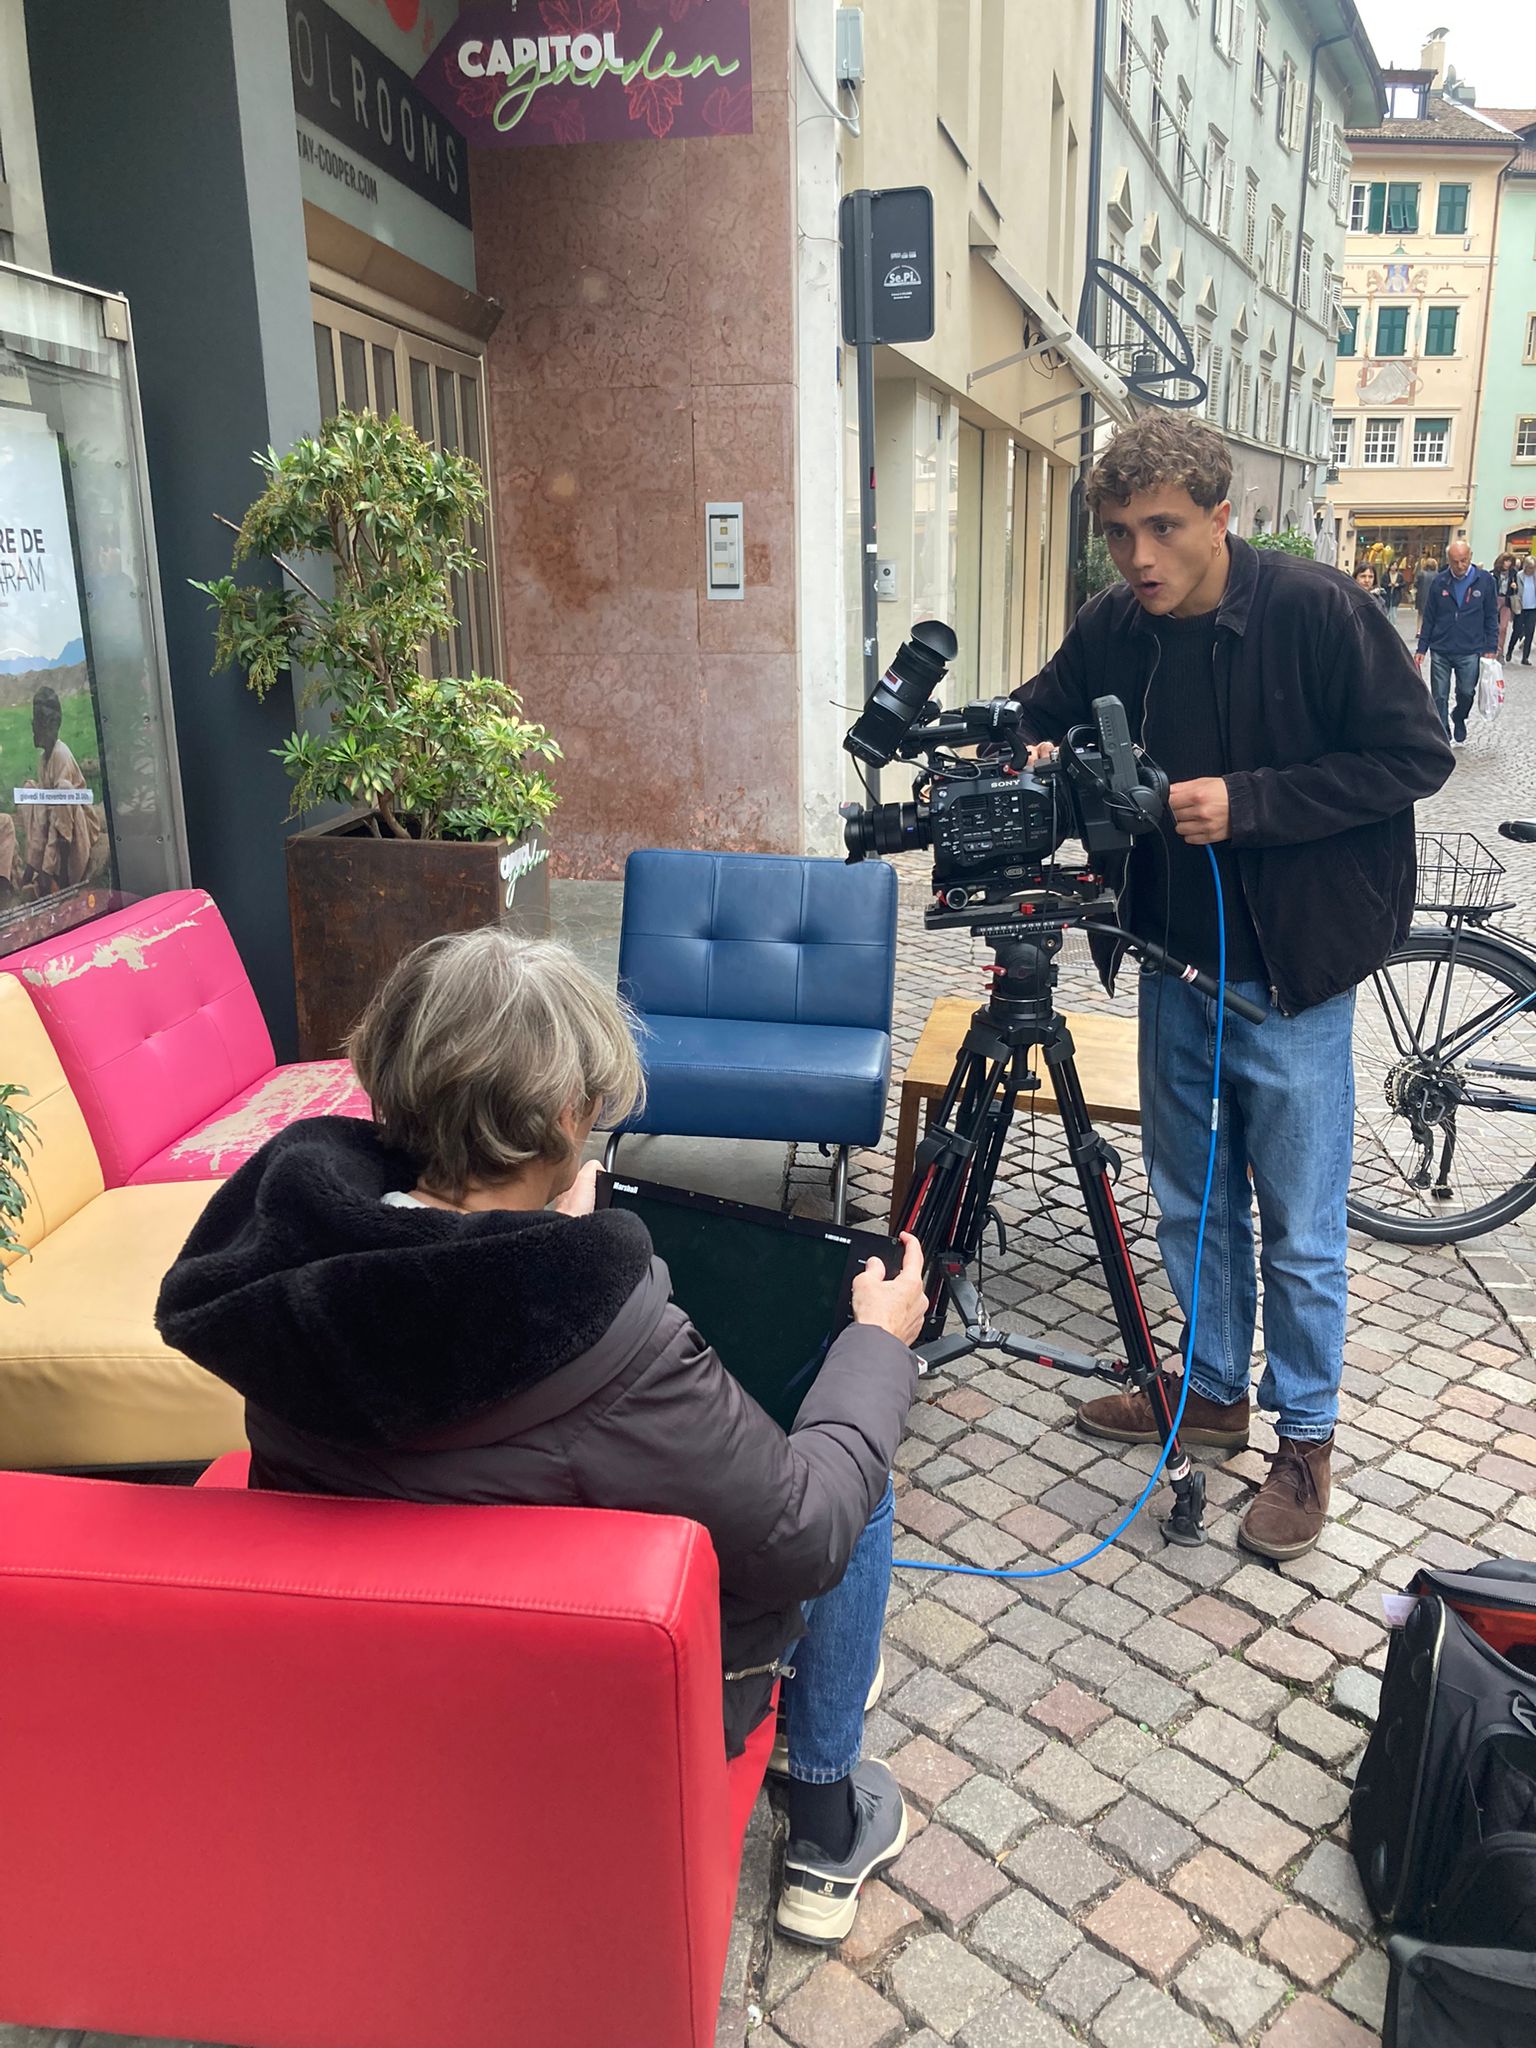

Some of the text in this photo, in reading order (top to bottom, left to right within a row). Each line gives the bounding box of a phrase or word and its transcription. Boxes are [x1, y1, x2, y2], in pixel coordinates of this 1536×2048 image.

[457, 31, 624, 78] CAPITOL
[493, 26, 740, 132] garden
[351, 54, 458, 194] ROOMS
[21, 528, 45, 553] DE
[991, 780, 1021, 788] SONY
